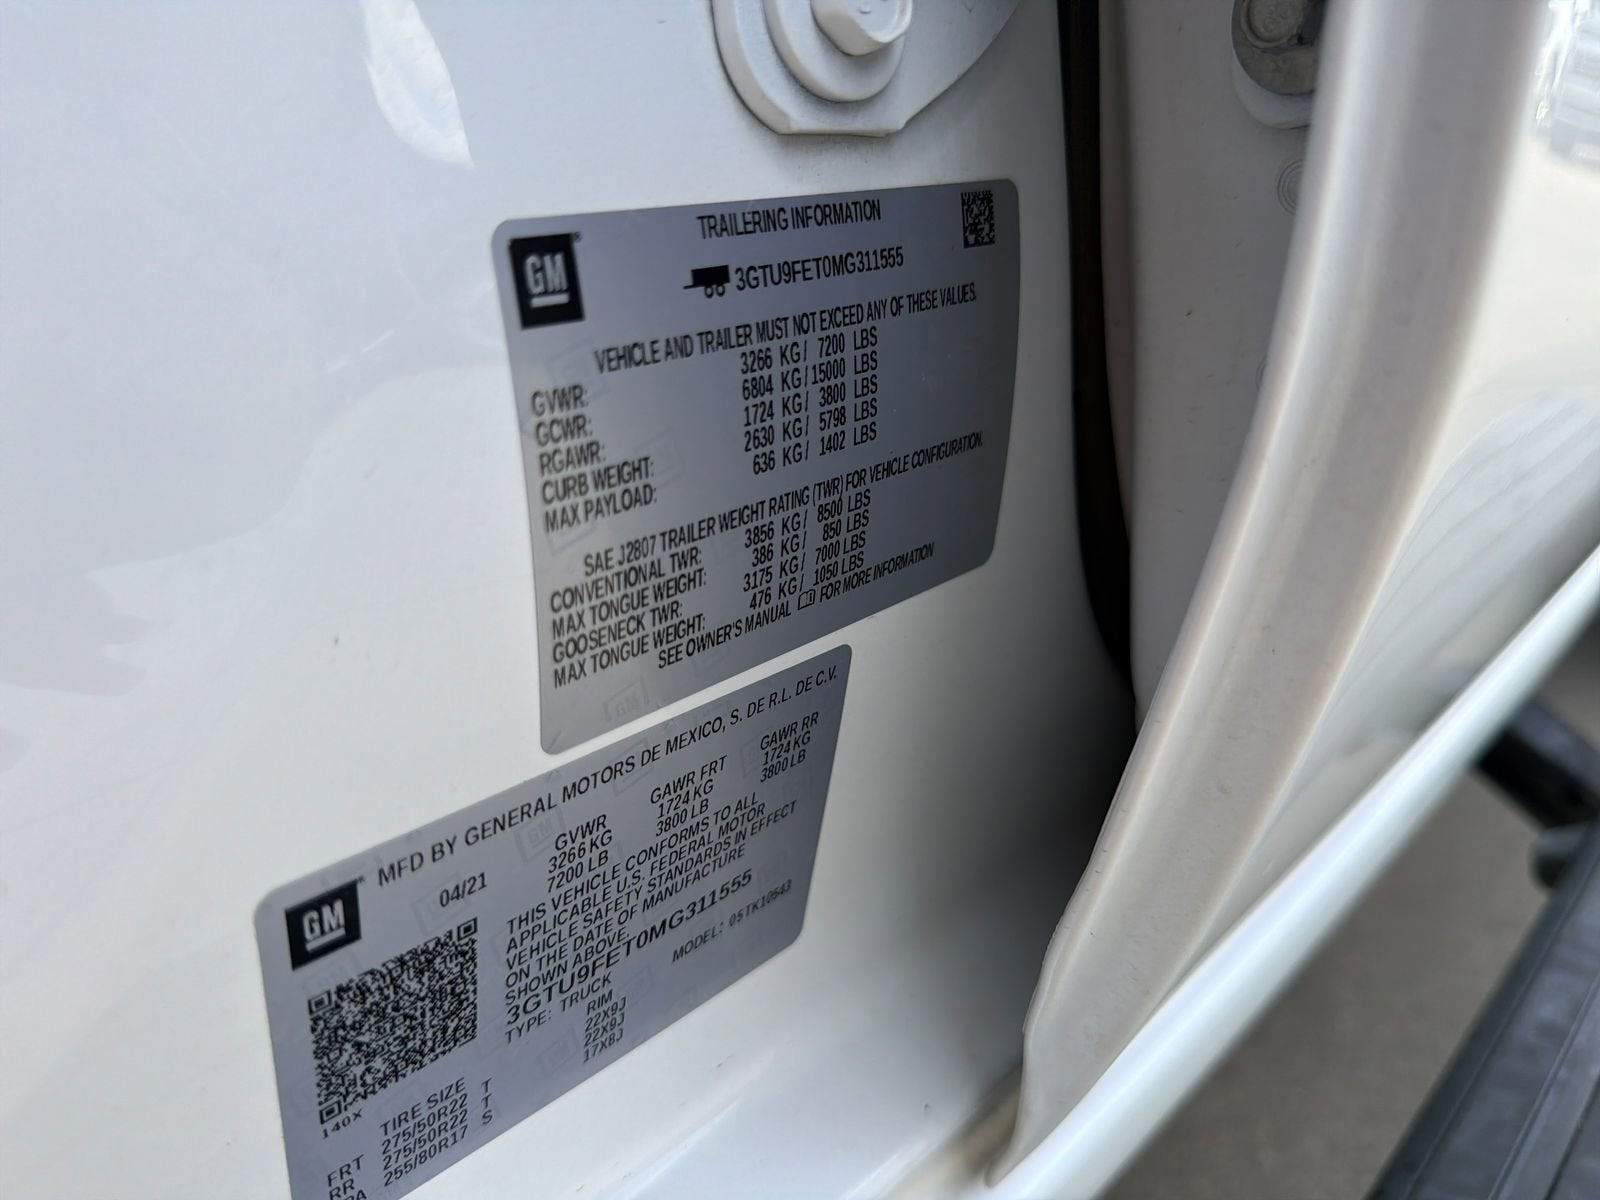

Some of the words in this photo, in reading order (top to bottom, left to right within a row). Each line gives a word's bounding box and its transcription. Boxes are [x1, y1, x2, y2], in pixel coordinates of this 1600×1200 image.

[697, 207, 789, 239] TRAILERING
[791, 199, 882, 230] INFORMATION
[524, 252, 568, 294] GM
[735, 246, 904, 291] 3GTU9FET0MG311555
[531, 384, 589, 417] GVWR:
[740, 347, 773, 374] 3266
[818, 332, 845, 358] 7200
[853, 326, 878, 350] LBS
[594, 340, 662, 374] VEHICLE
[664, 334, 694, 362] AND
[697, 323, 753, 355] TRAILER
[756, 316, 789, 345] MUST
[793, 311, 817, 336] NOT
[820, 303, 863, 332] EXCEED
[867, 298, 888, 322] ANY
[890, 295, 904, 317] OF
[906, 289, 938, 314] THESE
[940, 282, 977, 308] VALUES.
[535, 414, 593, 447] GCWR:
[742, 374, 774, 401] 6804
[811, 357, 846, 385] 15000
[853, 350, 878, 375] LBS
[539, 440, 606, 476] RGAWR:
[744, 400, 774, 427] 1724
[819, 381, 846, 408] 3800
[854, 374, 878, 399] LBS
[542, 472, 589, 505] CURB
[592, 456, 655, 492] WEIGHT:
[744, 424, 775, 452] 2630
[819, 405, 846, 431] 5798
[854, 397, 878, 422] LBS
[544, 503, 581, 533] MAX
[584, 483, 657, 522] PAYLOAD:
[752, 450, 775, 475] 636
[819, 430, 846, 456] 1402
[853, 421, 877, 446] LBS
[550, 558, 666, 613] CONVENTIONAL
[669, 546, 702, 573] TWR:
[744, 520, 774, 548] 3856
[817, 499, 843, 523] 8500
[847, 488, 870, 512] LBS
[584, 548, 615, 577] SAE
[618, 535, 657, 565] J2807
[660, 516, 716, 550] TRAILER
[718, 500, 766, 533] WEIGHT
[769, 486, 809, 517] RATING
[813, 474, 843, 506] (TWR)
[845, 468, 866, 491] FOR
[869, 454, 909, 483] VEHICLE
[911, 431, 983, 468] CONFIGURATION.
[552, 607, 585, 640] MAX
[590, 587, 649, 626] TONGUE
[653, 568, 706, 603] WEIGHT:
[752, 543, 773, 567] 386
[822, 519, 841, 541] 850
[847, 509, 869, 533] LBS
[552, 612, 645, 663] GOOSENECK
[650, 600, 683, 627] TWR:
[743, 566, 773, 592] 3175
[815, 540, 840, 565] 7000
[843, 531, 866, 554] LBS
[554, 657, 587, 688] MAX
[591, 635, 649, 673] TONGUE
[652, 613, 706, 649] WEIGHT:
[750, 587, 772, 610] 476
[813, 561, 839, 586] 1050
[841, 551, 864, 575] LBS
[658, 643, 683, 669] SEE
[686, 618, 743, 658] OWNER'S
[745, 600, 791, 634] MANUAL
[820, 580, 841, 603] FOR
[843, 566, 871, 595] MORE
[873, 542, 934, 578] INFORMATION
[378, 851, 424, 887] MFD
[431, 834, 458, 863] BY
[464, 792, 557, 847] GENERAL
[562, 755, 636, 803] MOTORS
[641, 743, 661, 767] DE
[665, 716, 726, 756] MEXICO,
[730, 708, 742, 726] S.
[747, 697, 765, 719] DE
[768, 687, 792, 709] R.L.
[796, 675, 813, 696] DE
[815, 665, 837, 687] C.V.
[760, 721, 798, 751] GAWR
[801, 711, 819, 733] RR
[760, 760, 788, 783] 3800
[790, 748, 807, 767] LB
[763, 743, 791, 766] 1724
[792, 730, 811, 750] KG
[650, 771, 696, 804] GAWR
[701, 755, 728, 781] FRT
[656, 810, 688, 836] 3800
[691, 798, 709, 819] LB
[657, 795, 689, 819] 1724
[693, 778, 714, 800] KG
[506, 886, 611, 954] APPLICABLE
[617, 869, 645, 894] U.S.
[650, 831, 713, 876] FEDERAL
[718, 802, 765, 839] MOTOR
[507, 902, 546, 934] THIS
[551, 862, 621, 911] VEHICLE
[625, 816, 709, 872] CONFORMS
[713, 805, 731, 825] TO
[733, 791, 758, 815] ALL
[547, 861, 584, 893] 7200
[588, 849, 609, 872] LB
[548, 841, 586, 874] 3266
[589, 829, 613, 851] KG
[555, 813, 607, 851] GVWR
[302, 899, 345, 942] GM
[438, 871, 487, 908] 04/21
[505, 964, 530, 988] ON
[536, 942, 568, 972] THE
[573, 920, 614, 952] DATE
[617, 903, 638, 926] OF
[642, 843, 746, 913] MANUFACTURE
[506, 920, 578, 971] VEHICLE
[583, 885, 642, 929] SAFETY
[647, 836, 731, 893] STANDARDS
[734, 828, 747, 845] IN
[750, 799, 797, 836] EFFECT
[505, 960, 568, 1006] SHOWN
[572, 926, 629, 969] ABOVE.
[507, 868, 753, 1025] 3GTU9FET0MG311555
[672, 921, 724, 962] MODEL:
[505, 1009, 551, 1044] TYPE:
[560, 972, 612, 1013] TRUCK
[327, 1154, 365, 1187] FRT
[381, 1093, 468, 1155] 275/50R22
[482, 1078, 492, 1094] T
[585, 996, 626, 1032] 22X9J
[329, 1178, 354, 1200] RR
[382, 1109, 468, 1171] 275/50R22
[482, 1094, 492, 1109] T
[584, 1011, 625, 1047] 22X9J
[381, 1102, 422, 1136] TIRE
[427, 1077, 466, 1110] SIZE
[587, 989, 613, 1015] RIM
[384, 1124, 468, 1187] 255/80R17
[482, 1109, 493, 1126] S
[584, 1028, 623, 1062] 17X8J
[322, 1109, 362, 1139] 140X
